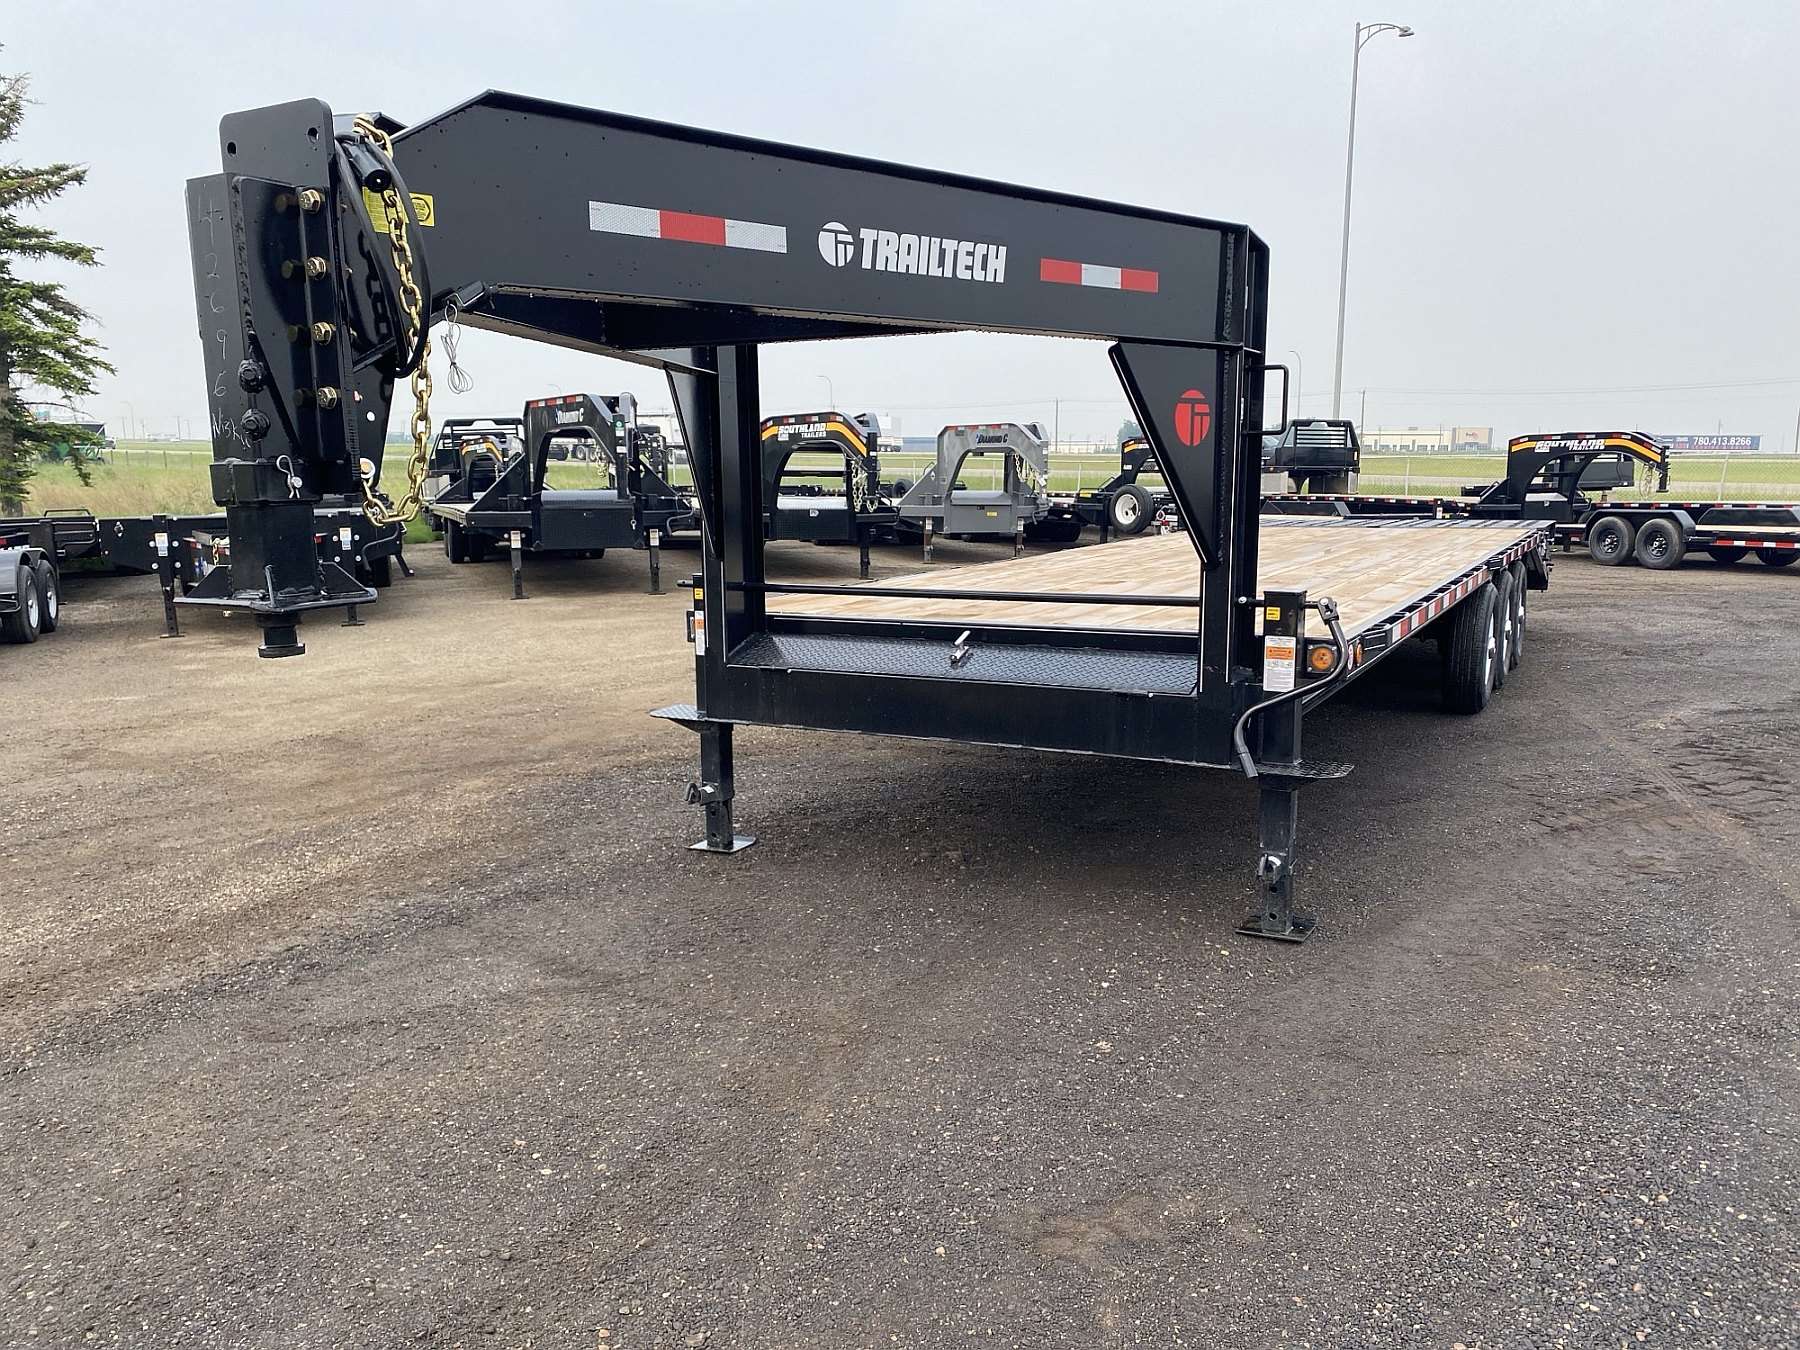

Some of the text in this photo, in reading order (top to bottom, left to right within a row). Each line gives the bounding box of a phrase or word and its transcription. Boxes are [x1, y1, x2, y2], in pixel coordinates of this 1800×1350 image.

[859, 227, 1007, 283] TRAILTECH
[779, 423, 827, 433] SOUTHLAND
[1693, 436, 1752, 446] 780.413.8266
